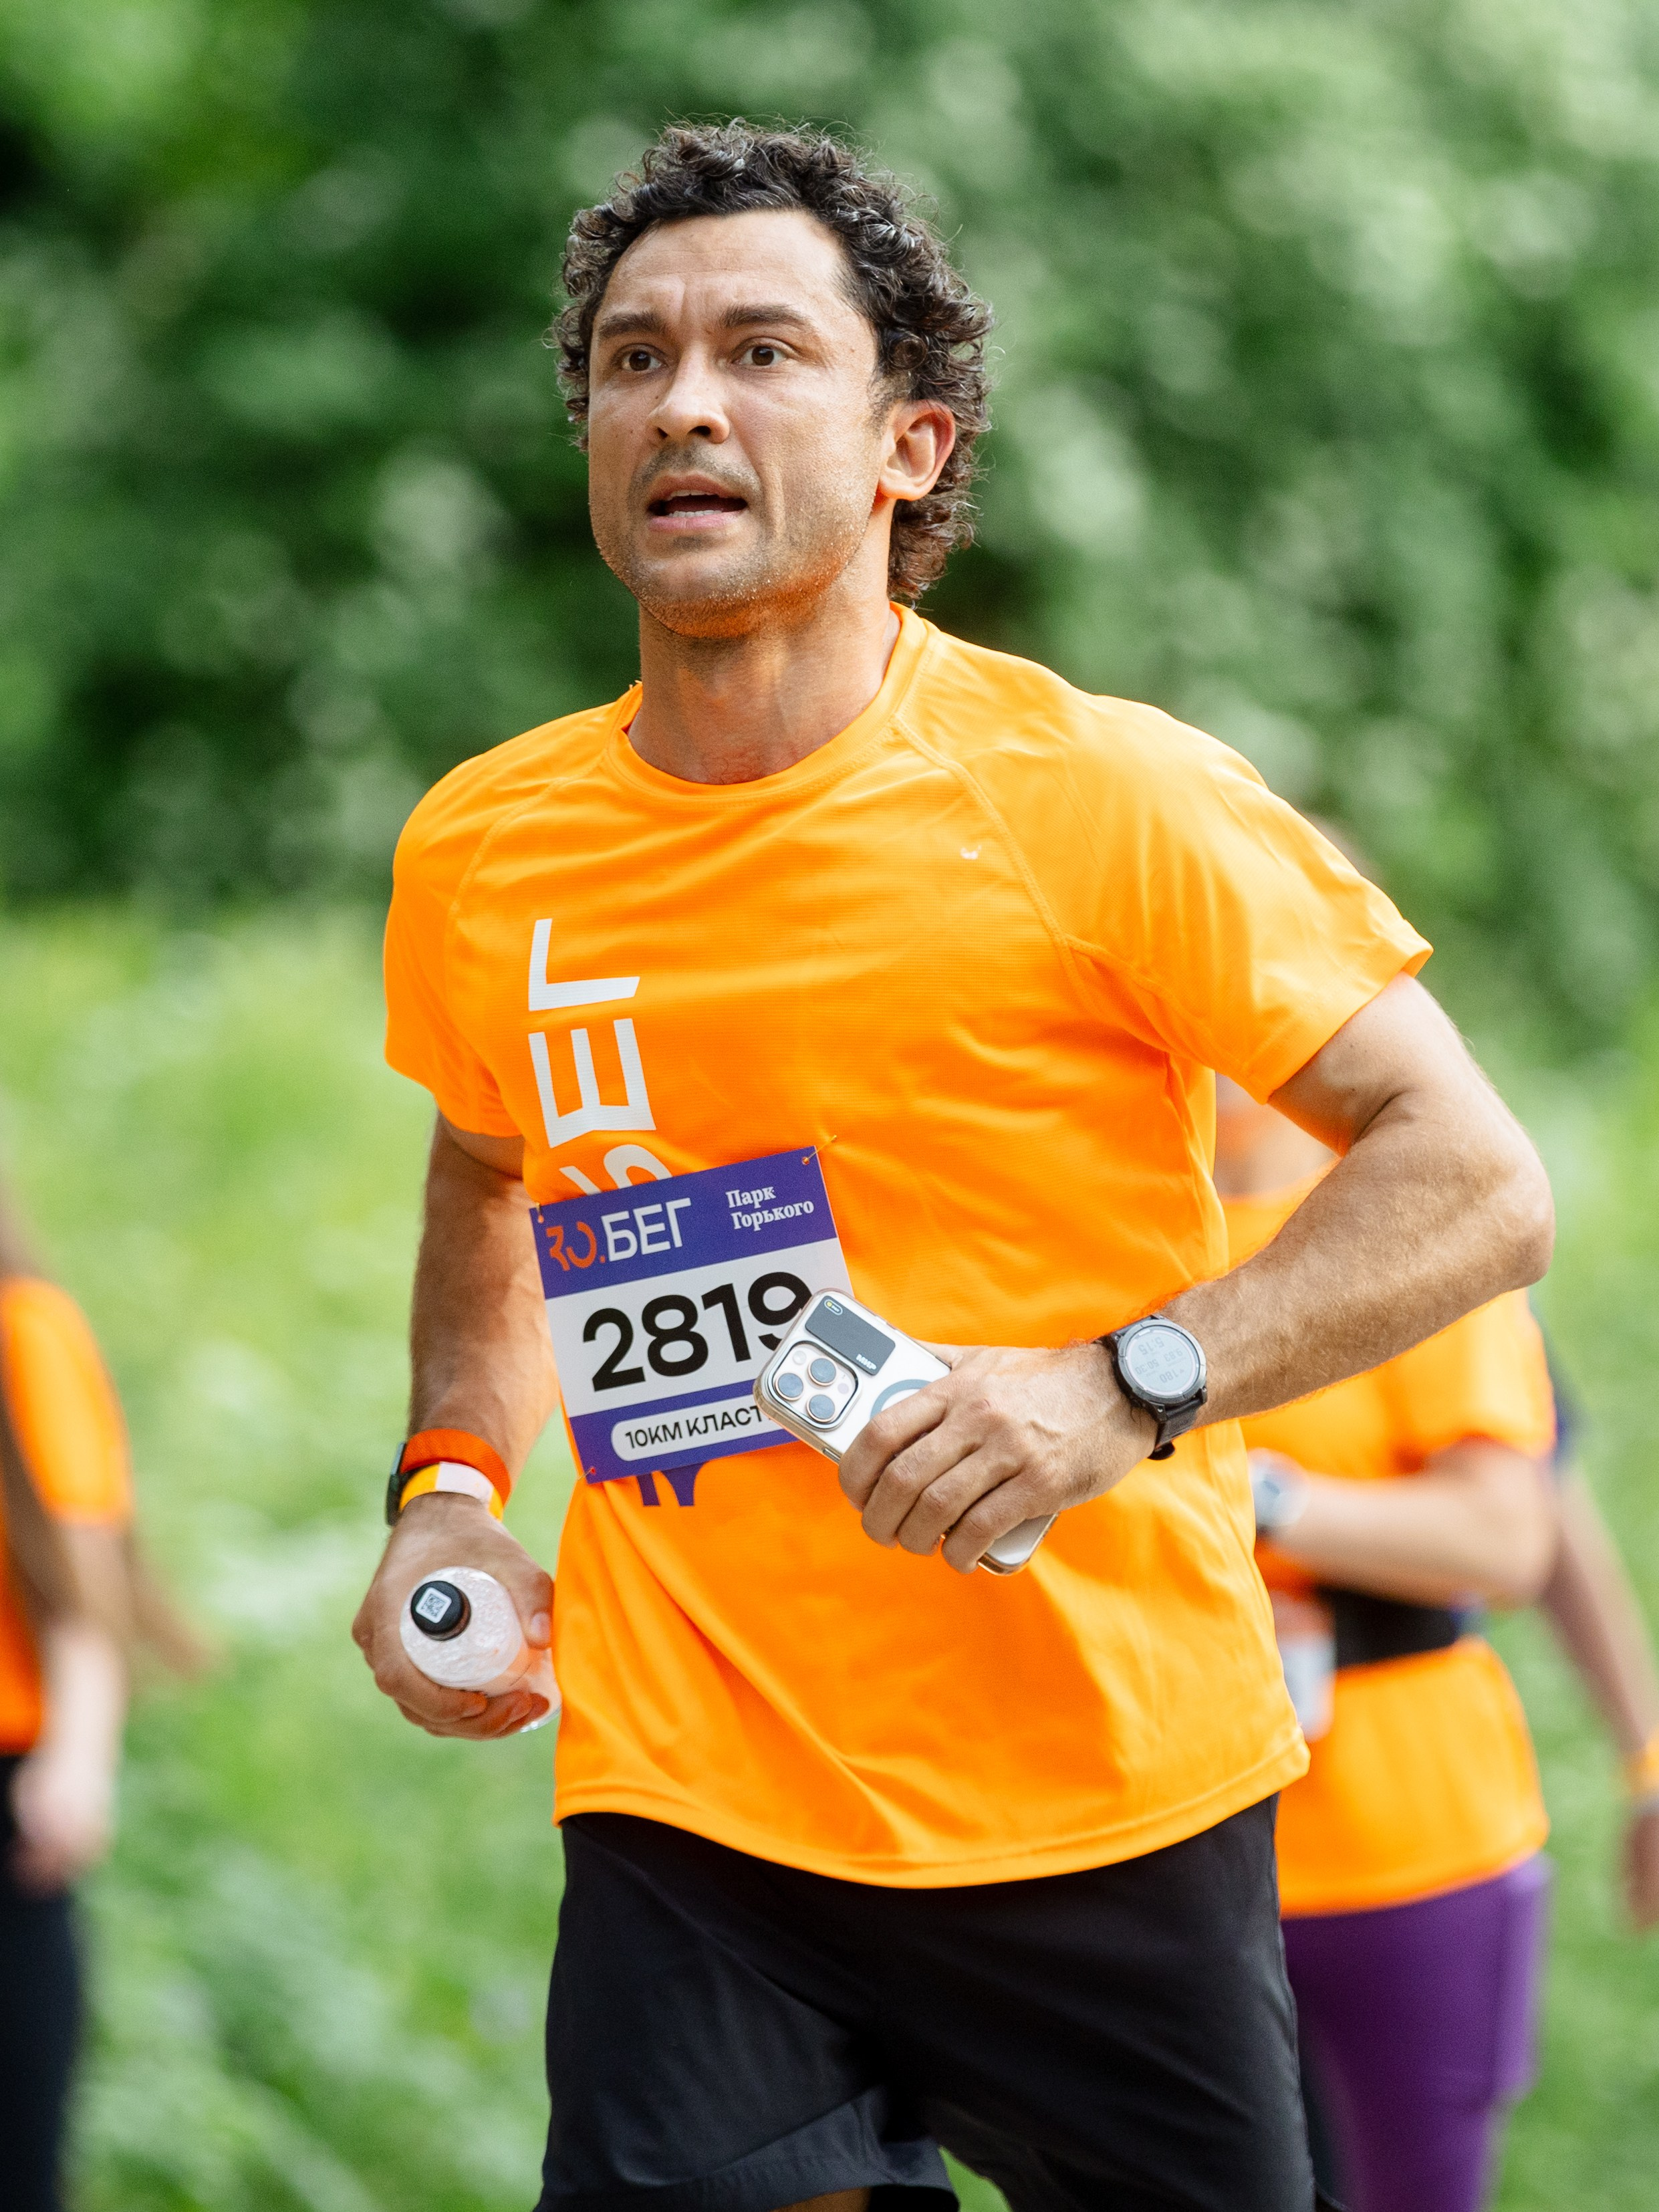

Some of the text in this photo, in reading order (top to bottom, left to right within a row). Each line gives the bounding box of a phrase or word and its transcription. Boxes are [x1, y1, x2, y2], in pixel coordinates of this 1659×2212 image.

[725, 1187, 777, 1209] Парк
[731, 1201, 814, 1231] Горького
[582, 1271, 811, 1392] 2819
[625, 1404, 771, 1449] 10КМ КЛАСТ
